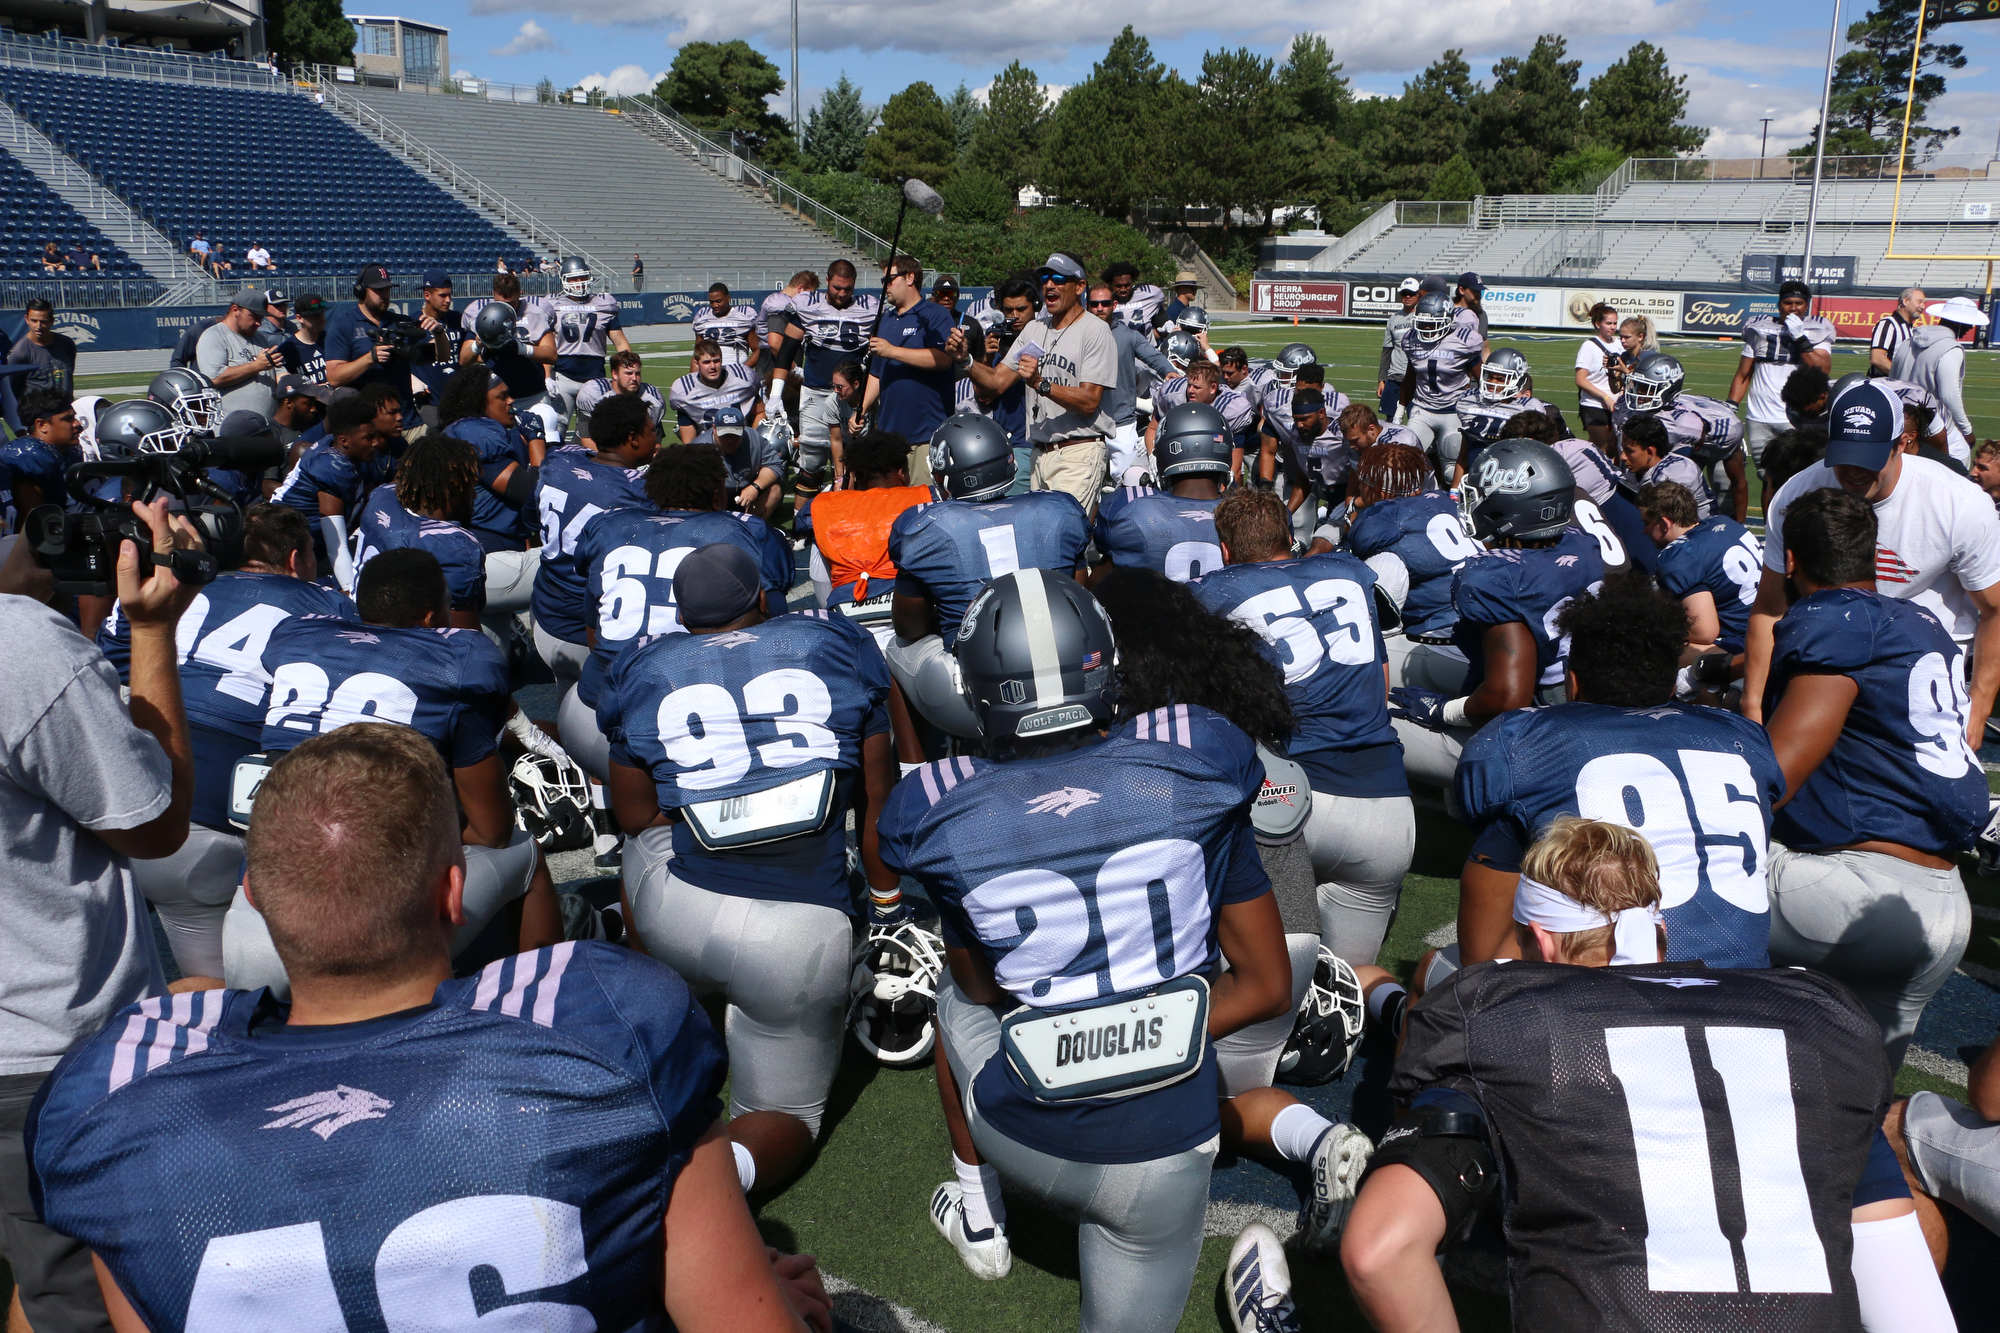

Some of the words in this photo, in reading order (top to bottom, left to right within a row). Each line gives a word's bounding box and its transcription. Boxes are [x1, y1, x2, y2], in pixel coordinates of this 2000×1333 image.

[1782, 267, 1812, 277] WOL
[1815, 268, 1845, 278] PACK
[1273, 285, 1303, 293] SIERRA
[1273, 293, 1338, 302] NEUROSURGERY
[623, 300, 643, 309] BOWL
[663, 294, 695, 307] NEVADA
[738, 298, 755, 306] BOWL
[1273, 300, 1301, 308] GROUP
[1603, 298, 1645, 306] LOCAL
[1648, 299, 1674, 307] 350
[53, 312, 101, 330] EVADA
[1685, 301, 1744, 326] Ford
[561, 312, 597, 343] 67
[304, 357, 327, 373] EVA
[1038, 352, 1077, 378] EVADA
[1428, 359, 1438, 392] 1
[1843, 405, 1877, 419] NEVADA
[1843, 427, 1871, 435] FOOTBALL
[1178, 464, 1198, 472] WOLF
[1200, 463, 1218, 471] PACK
[1479, 457, 1533, 494] Pack
[1574, 499, 1626, 566] 6
[978, 524, 1020, 578] 1
[852, 594, 892, 608] DOUGLA
[1226, 578, 1375, 686] 53
[657, 668, 840, 790] 93
[1023, 713, 1054, 731] WOLF
[1058, 709, 1087, 724] PACK
[1261, 785, 1296, 797] OWER
[1257, 799, 1279, 808] Riddell
[1576, 750, 1771, 914] 95
[962, 839, 1211, 1009] 20
[1055, 1016, 1164, 1068] DOUGLAS
[1604, 1026, 1833, 1294] 11
[1315, 1155, 1330, 1229] adidas
